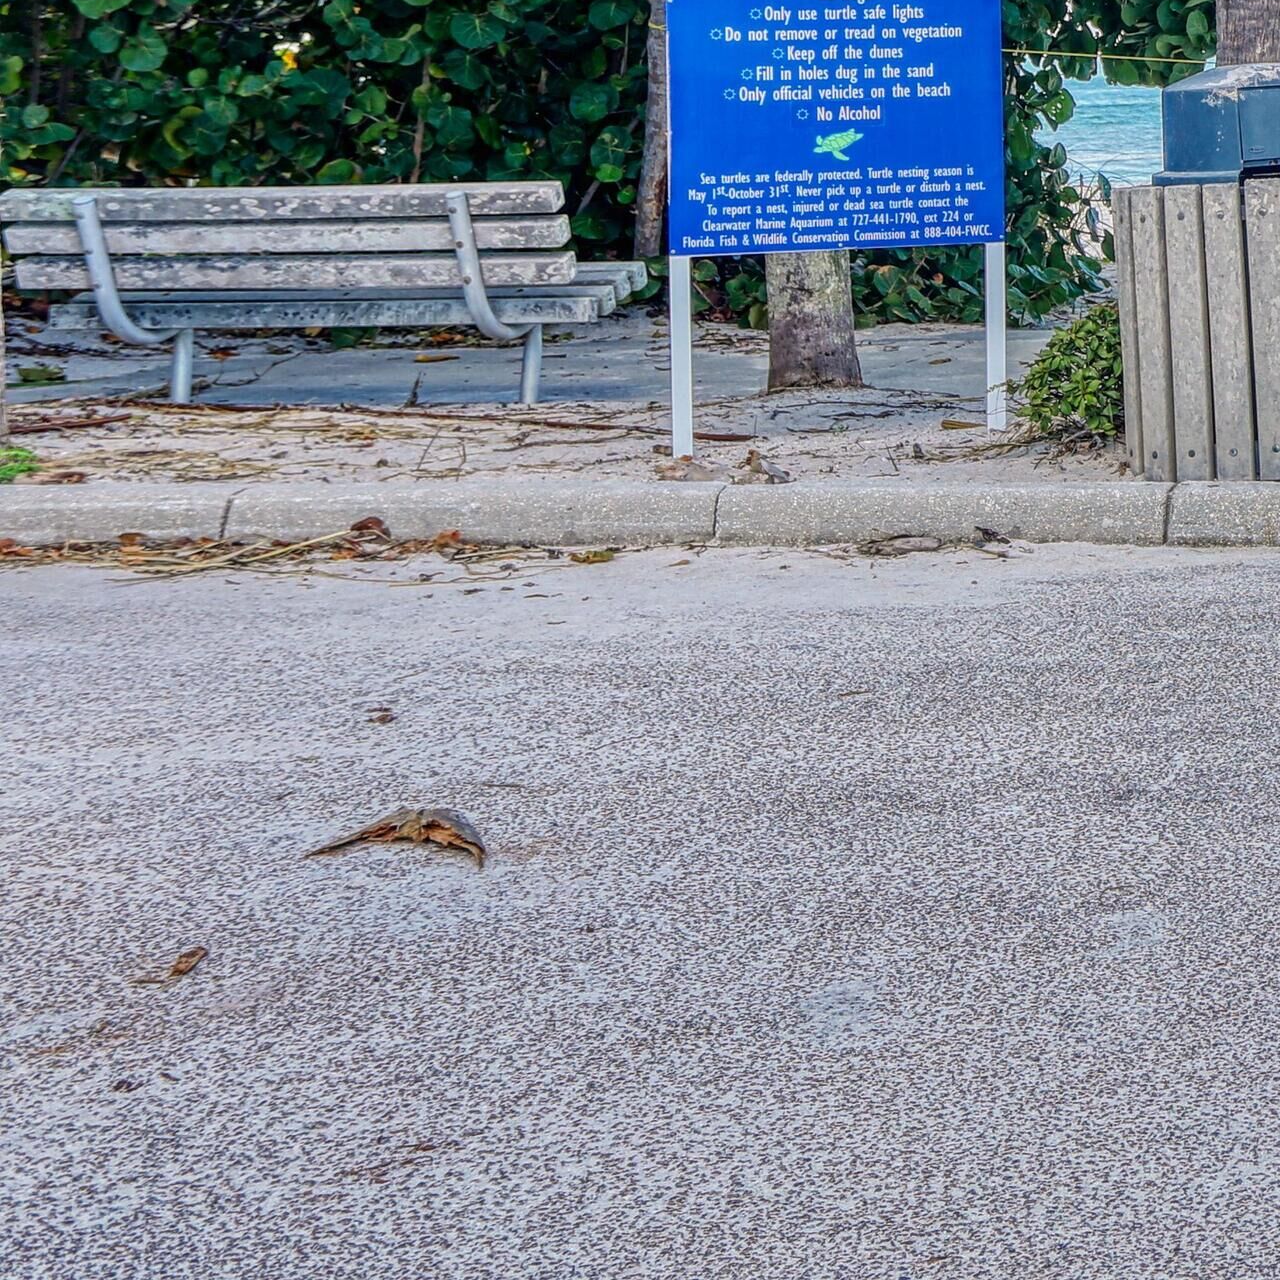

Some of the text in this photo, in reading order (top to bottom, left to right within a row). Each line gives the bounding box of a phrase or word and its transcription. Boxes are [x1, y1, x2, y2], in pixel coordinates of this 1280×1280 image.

[765, 5, 924, 25] Only use turtle safe lights
[725, 23, 962, 42] Do not remove or tread on vegetation
[788, 44, 903, 64] Keep off the dunes
[757, 63, 933, 83] Fill in holes dug in the sand
[740, 82, 950, 105] Only official vehicles on the beach
[817, 105, 880, 121] No Alcohol
[707, 204, 717, 215] To
[723, 203, 751, 218] report
[767, 202, 788, 214] nest,
[793, 201, 824, 216] injured
[829, 203, 839, 211] or
[844, 199, 865, 211] dead
[870, 202, 884, 210] sea
[889, 198, 913, 209] turtle
[919, 197, 950, 208] contact
[955, 196, 968, 207] the
[703, 211, 973, 232] Clearwater Marine Aquarium at 727-441-1790, ext 224 or
[683, 226, 992, 248] Florida Fish & Wildlife Conservation Commission at 888-404-FWCC.
